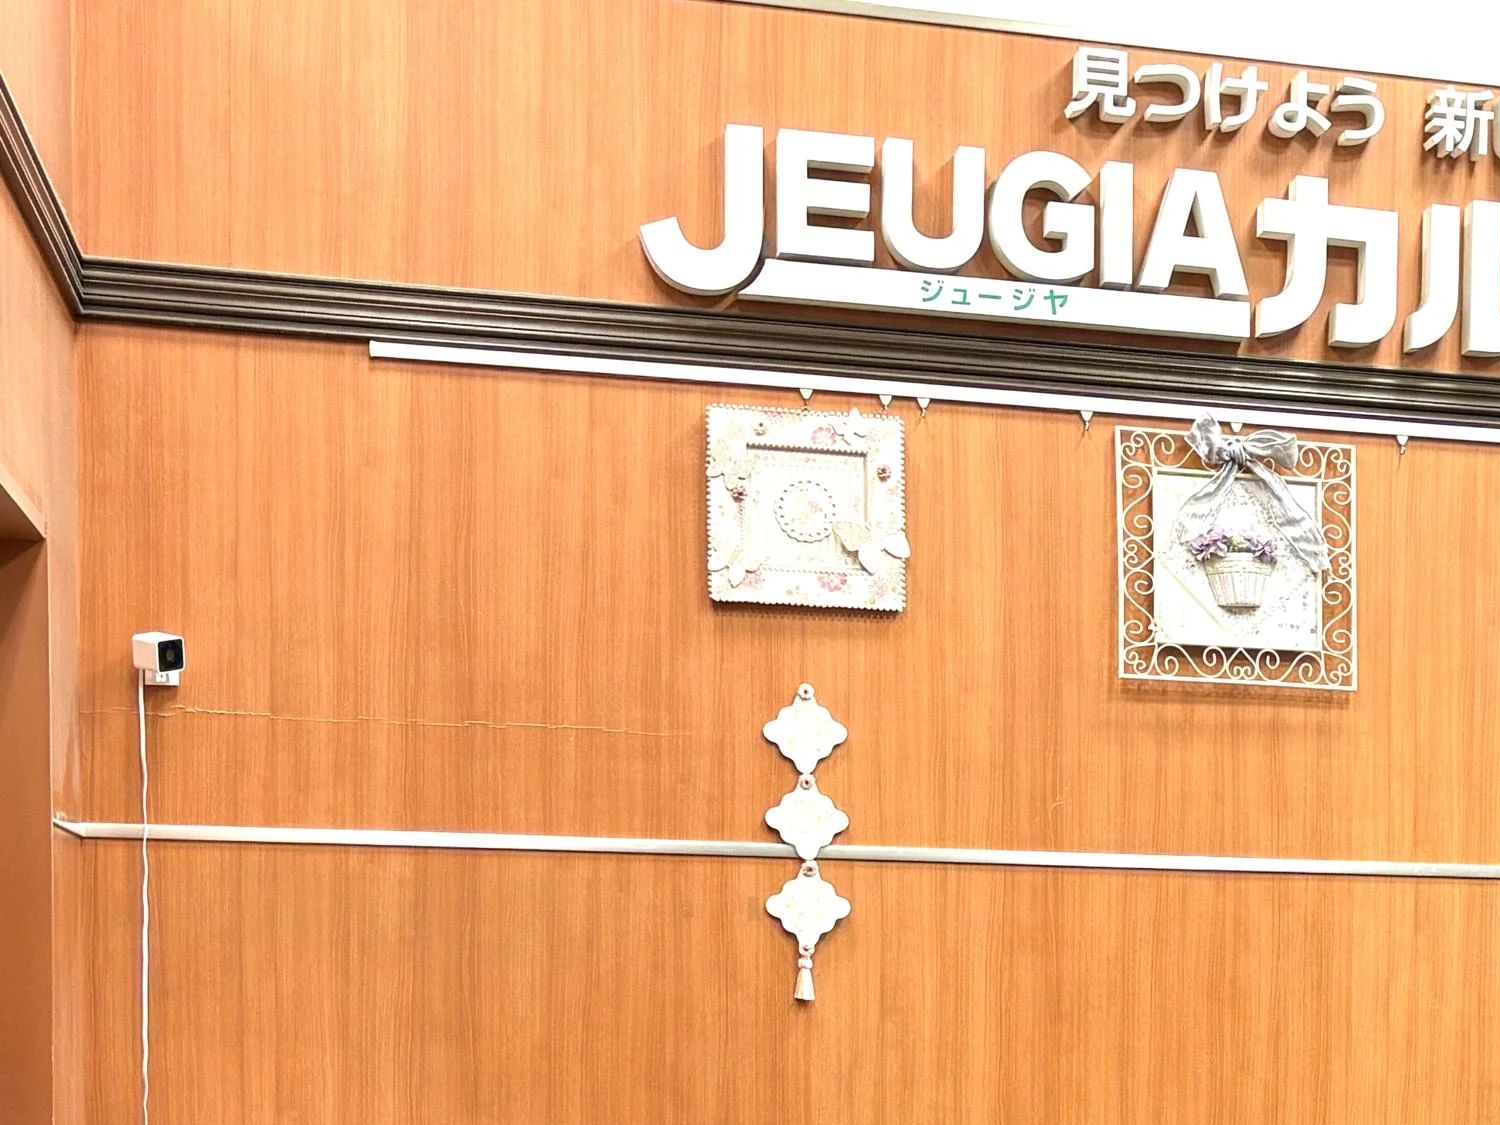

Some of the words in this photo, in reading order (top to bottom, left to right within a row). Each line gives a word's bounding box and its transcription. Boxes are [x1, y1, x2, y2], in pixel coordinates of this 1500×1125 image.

[1066, 46, 1386, 146] 見つけよう
